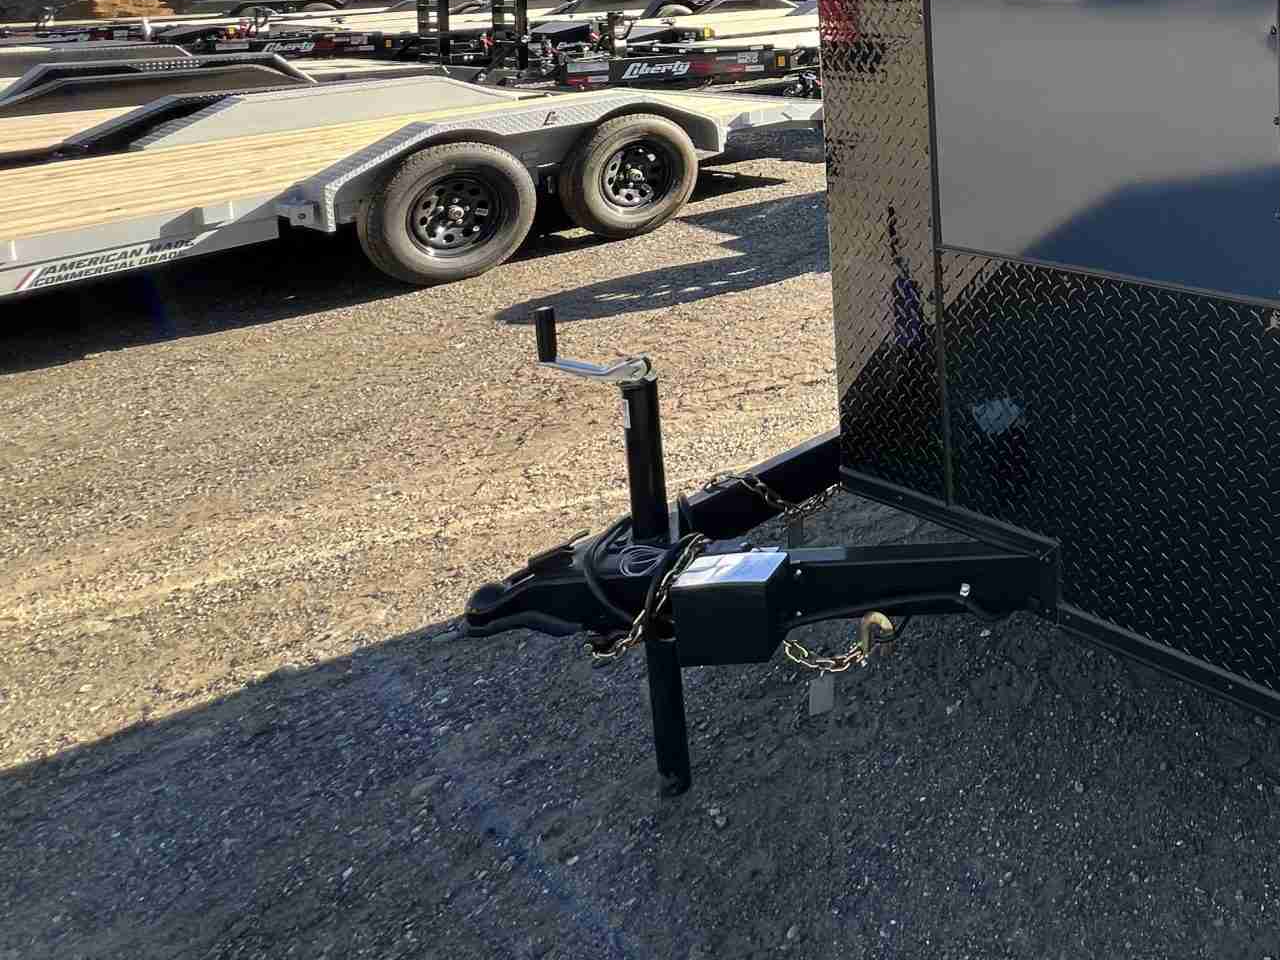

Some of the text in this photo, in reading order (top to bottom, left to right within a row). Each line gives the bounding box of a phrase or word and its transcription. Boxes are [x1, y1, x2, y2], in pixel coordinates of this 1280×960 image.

[622, 60, 690, 80] Liberty
[33, 259, 134, 287] COMMERCIAL
[39, 247, 143, 276] AMERICAN
